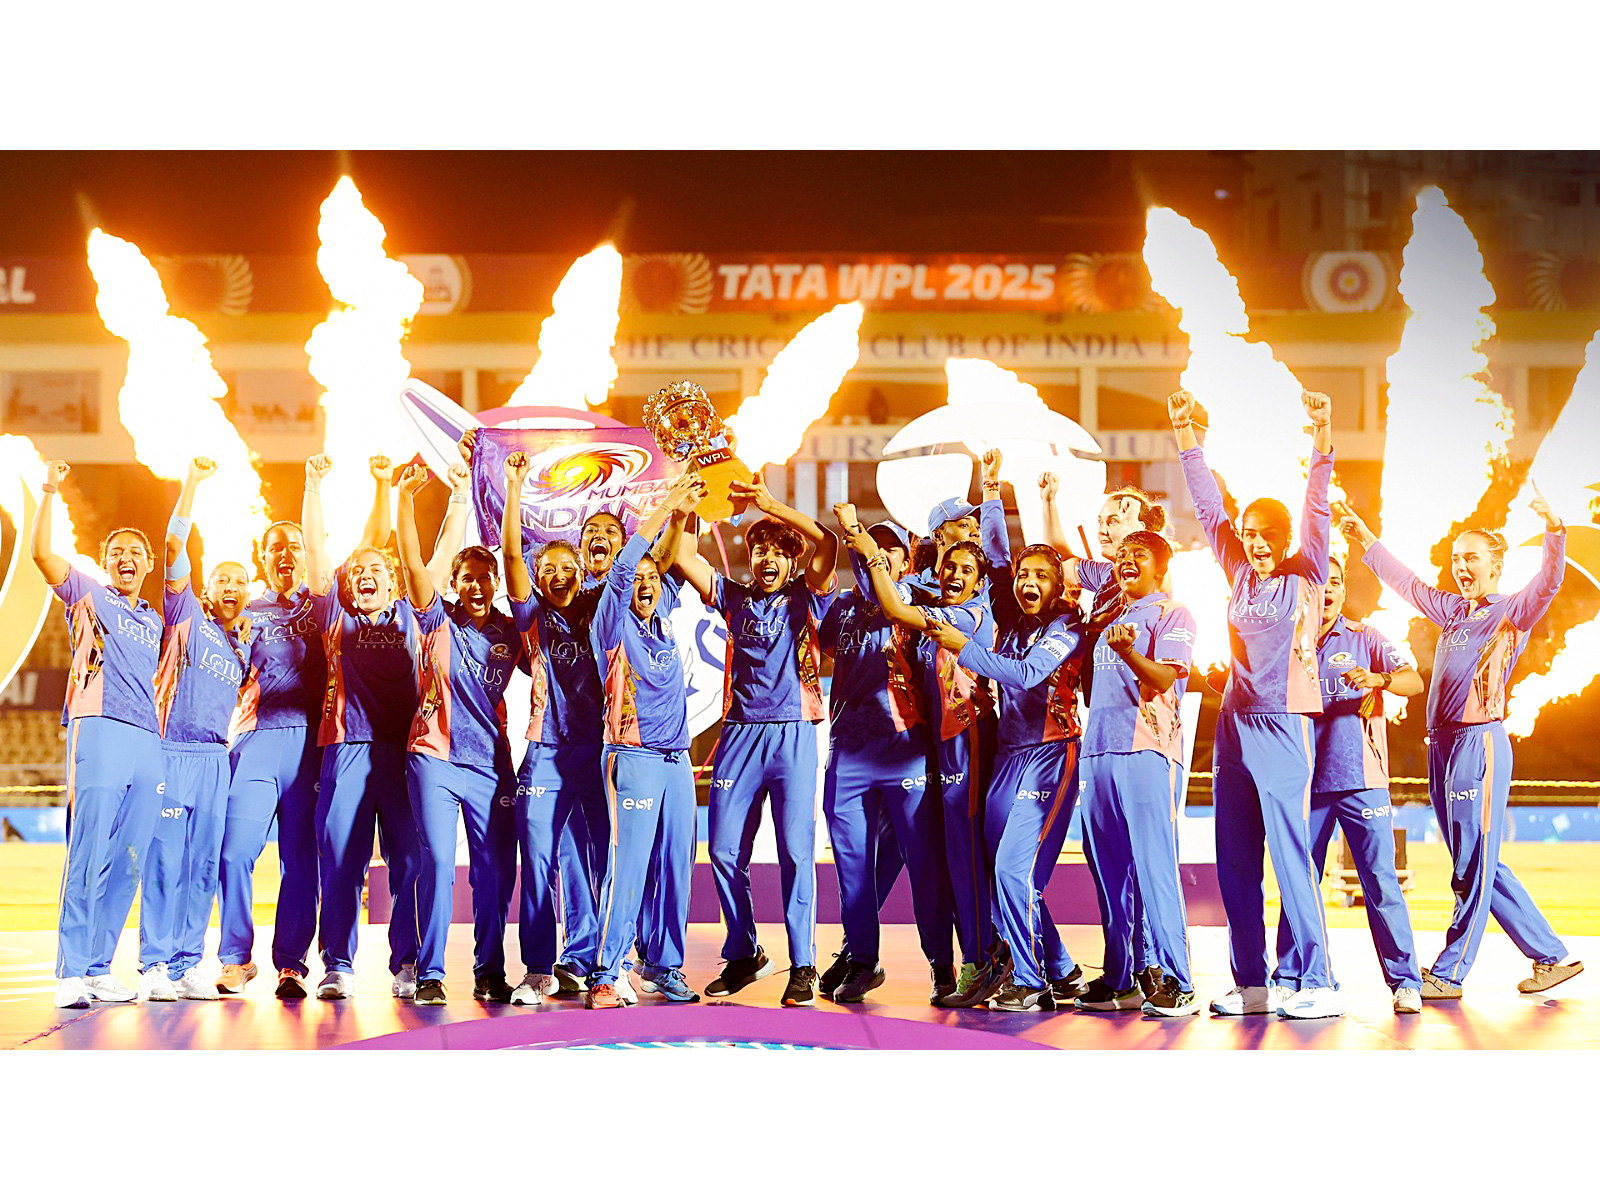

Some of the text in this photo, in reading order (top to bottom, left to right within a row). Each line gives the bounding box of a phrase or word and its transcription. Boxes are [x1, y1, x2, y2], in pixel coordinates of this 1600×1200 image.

[719, 263, 1056, 300] TATA WPL 2025
[870, 332, 966, 358] CLUB
[981, 332, 1030, 358] OF
[1044, 332, 1147, 358] INDIA
[697, 451, 730, 465] WPL
[587, 479, 673, 500] MUMBA
[199, 625, 224, 648] CAPITAL
[741, 615, 787, 636] LOTUS
